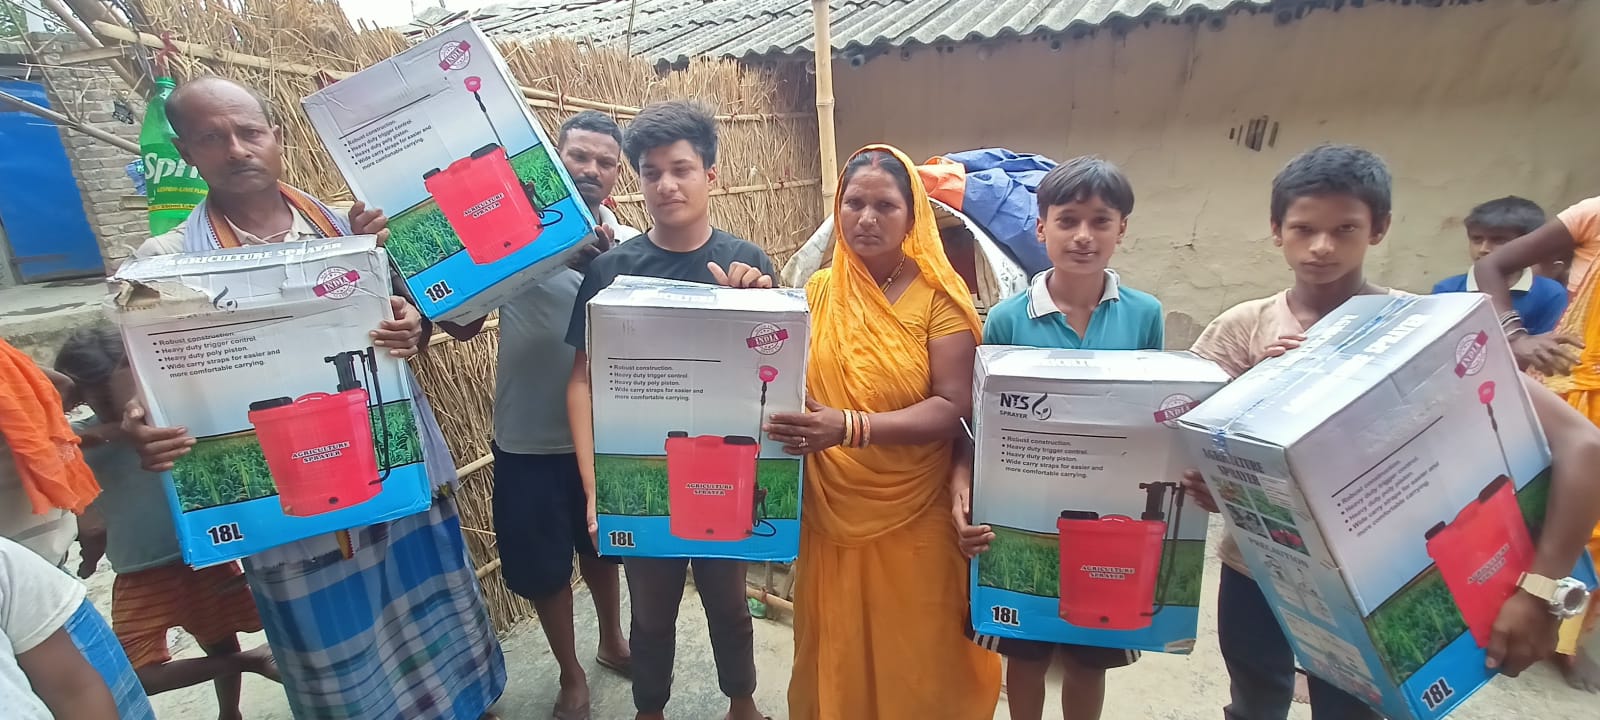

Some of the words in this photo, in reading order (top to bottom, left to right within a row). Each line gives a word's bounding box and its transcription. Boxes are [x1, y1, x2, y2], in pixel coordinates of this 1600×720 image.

[167, 252, 272, 265] AGRICULTURE
[323, 277, 351, 292] INDIA
[425, 280, 454, 303] 18L
[158, 338, 186, 347] Robust
[186, 343, 202, 351] duty
[204, 340, 229, 349] trigger
[755, 334, 779, 345] INDIA
[164, 354, 187, 362] Heavy
[188, 352, 205, 360] duty
[206, 349, 222, 358] poly
[166, 363, 186, 371] Wide
[186, 360, 205, 368] carry
[207, 356, 230, 365] straps
[243, 350, 266, 359] easier
[267, 348, 281, 356] and
[189, 364, 233, 377] comfortable
[633, 379, 646, 387] duty
[1000, 392, 1030, 410] NTS
[1000, 409, 1028, 419] SPRAYER
[1007, 436, 1030, 444] Robust
[292, 441, 349, 458] AGRICULTURE
[1006, 444, 1026, 452] Heavy
[1026, 445, 1041, 453] duty
[303, 450, 343, 463] SPRAYER
[1006, 451, 1025, 459] Heavy
[1041, 454, 1055, 462] poly
[1022, 468, 1060, 477] comfortable
[207, 522, 243, 546] 18L
[608, 530, 636, 547] 18L
[991, 605, 1021, 627] 18L
[1421, 676, 1455, 711] 18L
